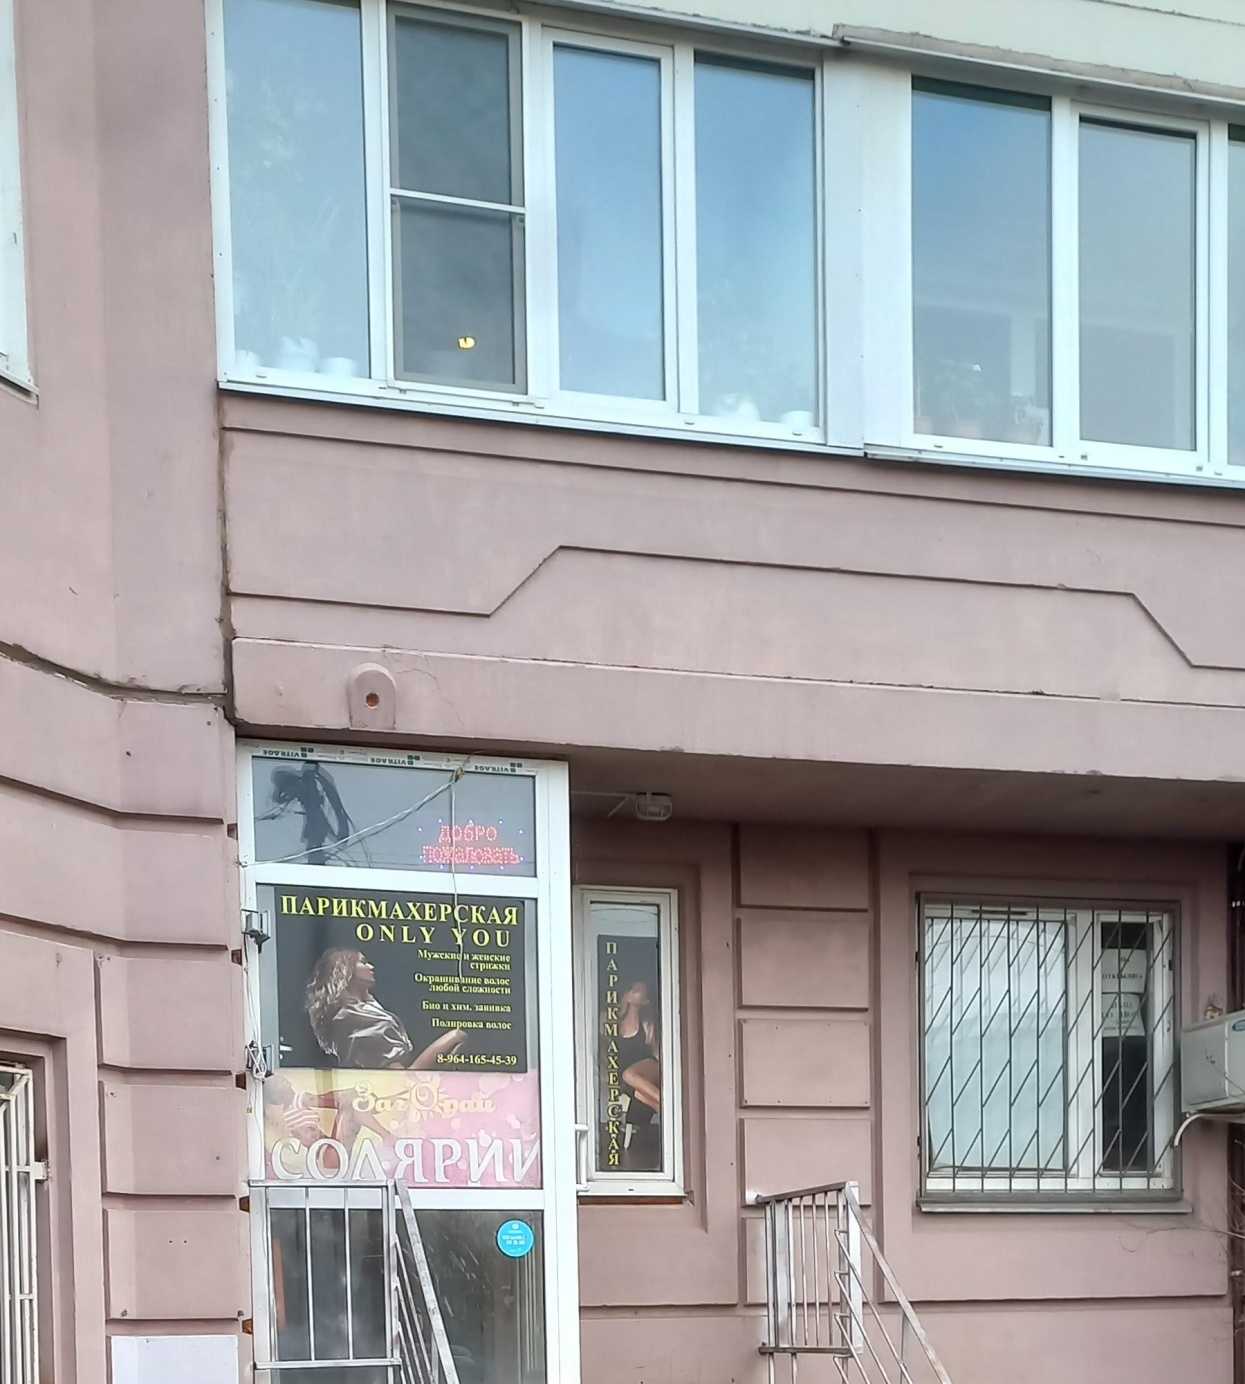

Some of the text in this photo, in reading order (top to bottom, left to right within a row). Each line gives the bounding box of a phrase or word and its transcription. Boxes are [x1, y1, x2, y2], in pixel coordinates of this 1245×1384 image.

[280, 895, 519, 926] ПАРИКМАХЕРСКАЯ
[356, 923, 510, 948] ONLY YOU
[463, 953, 470, 961] и
[471, 953, 511, 962] женские
[470, 962, 511, 972] стрижки
[484, 978, 510, 986] волос
[462, 986, 511, 995] сложности
[422, 1000, 511, 1013] Био и хим. завивка
[432, 1018, 512, 1031] Полировка волос
[437, 1053, 517, 1066] 8-964-165-45-39
[604, 942, 620, 1166] ПАРИКМАХЕРСКАЯ
